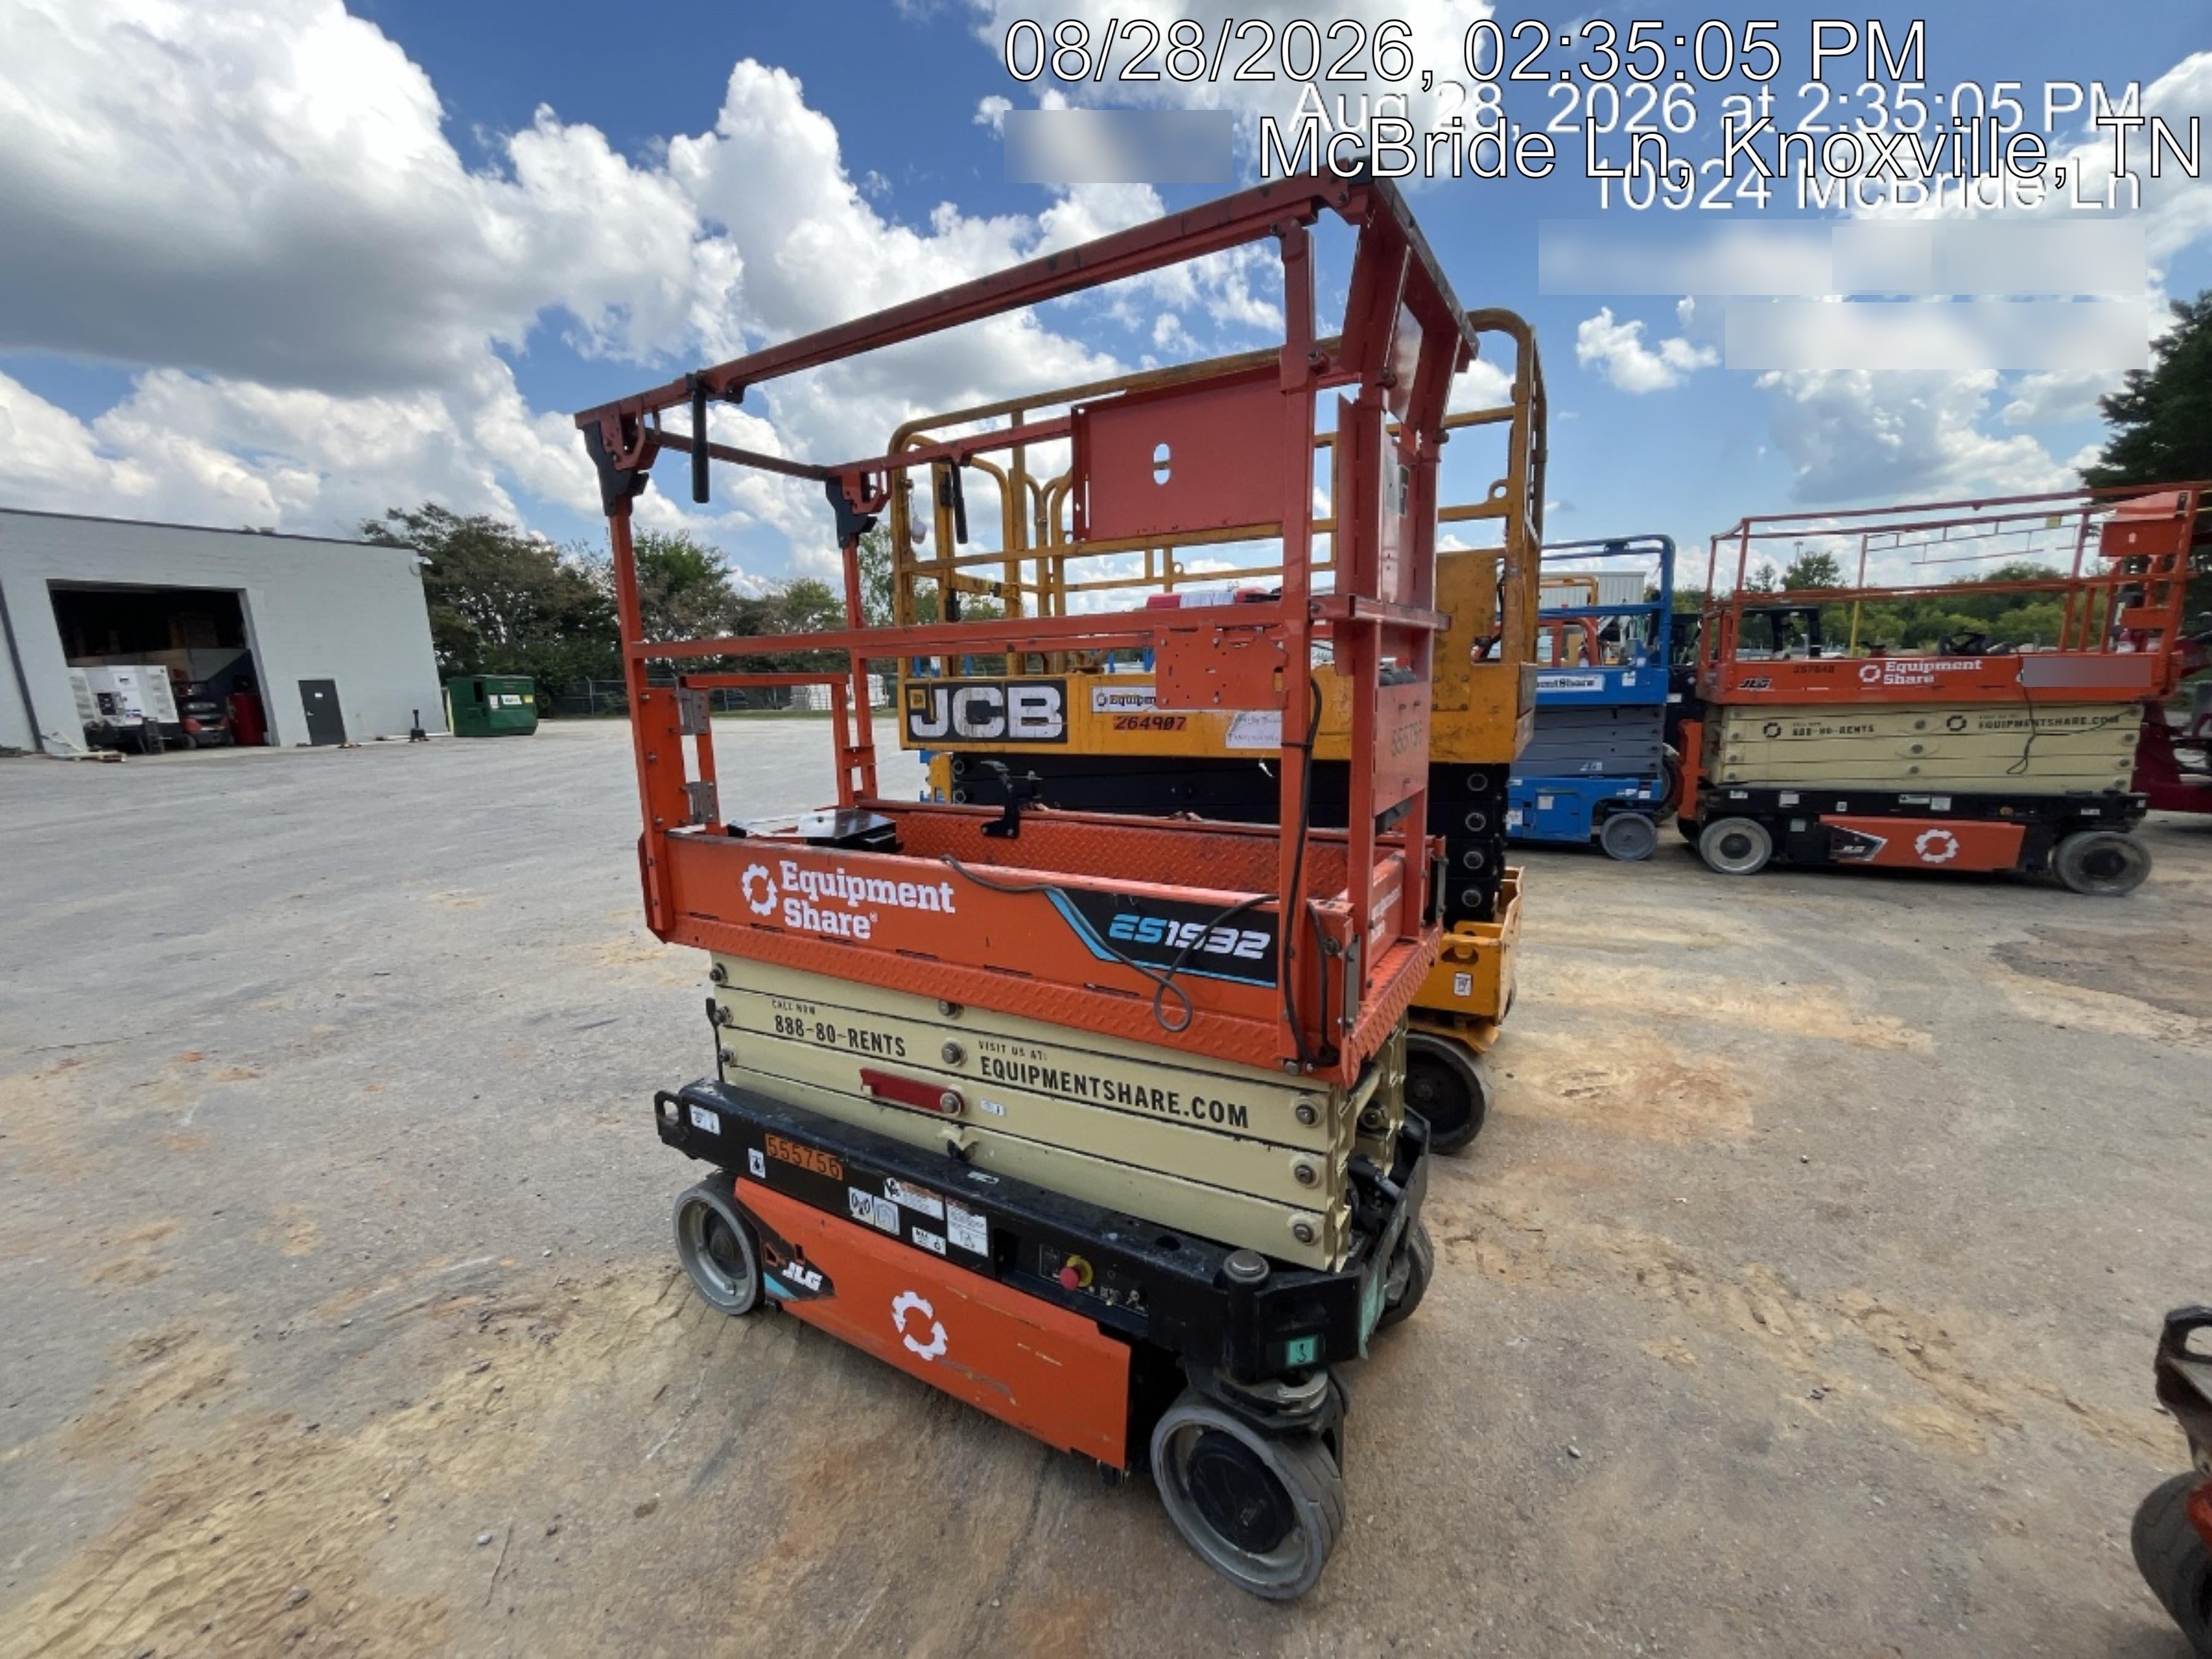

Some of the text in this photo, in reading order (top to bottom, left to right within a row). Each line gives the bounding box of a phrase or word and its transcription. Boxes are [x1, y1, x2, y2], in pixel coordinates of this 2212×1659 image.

[1885, 659, 1982, 673] Equipment
[1739, 678, 1771, 688] JLG
[1884, 673, 1935, 684] Share
[910, 686, 1062, 737] JCB
[1114, 715, 1186, 730] 264907
[779, 860, 955, 914] Equipment
[772, 999, 793, 1011] CALL
[775, 1014, 906, 1057] 888-80-RENTS
[979, 1040, 1006, 1053] VISIT
[1011, 1046, 1026, 1057] US
[981, 1056, 1249, 1129] EQUIPMENTSHARE.COM
[782, 1261, 823, 1291] JLG
